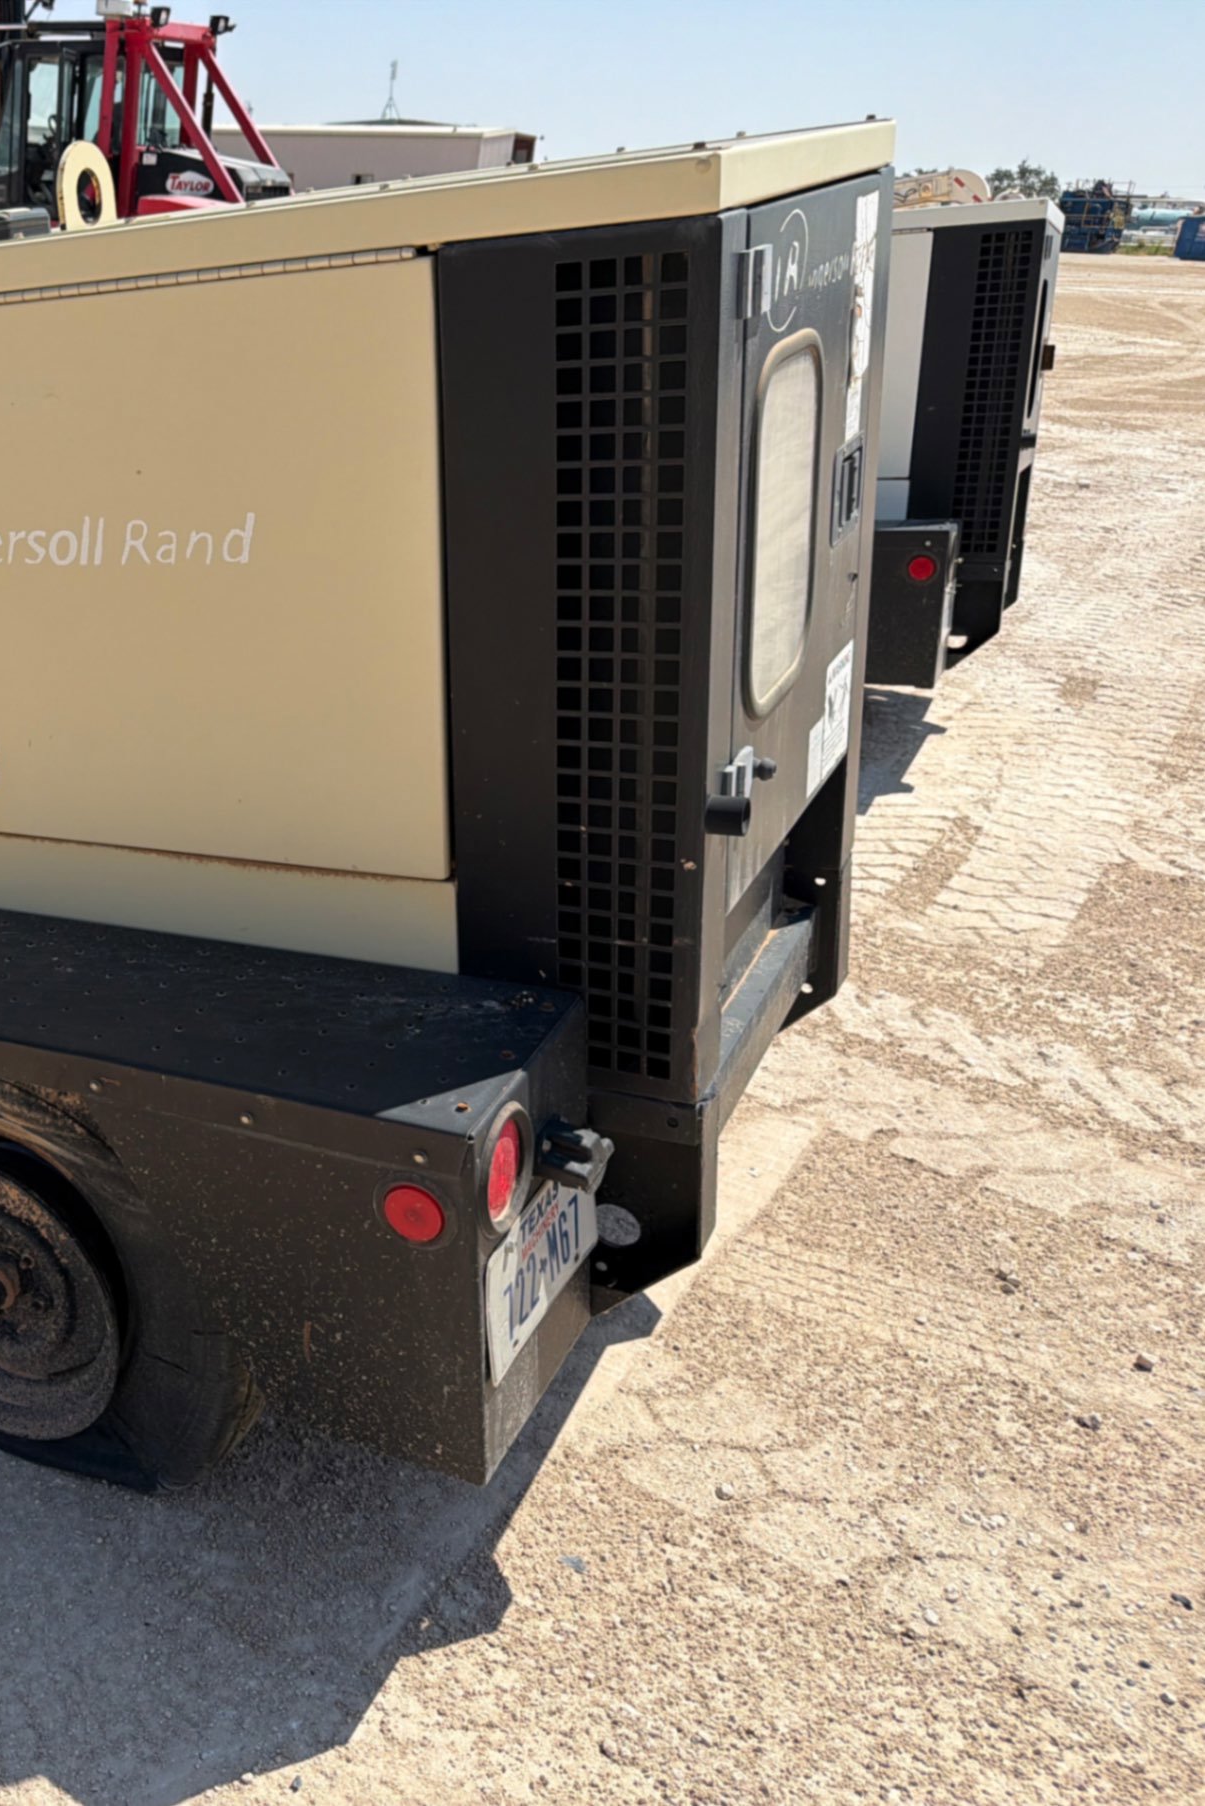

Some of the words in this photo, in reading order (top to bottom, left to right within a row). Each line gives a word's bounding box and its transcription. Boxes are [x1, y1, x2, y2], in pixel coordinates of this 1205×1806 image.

[170, 174, 212, 193] TAYLOR
[120, 512, 256, 566] Rand
[520, 1183, 558, 1244] TEXAS
